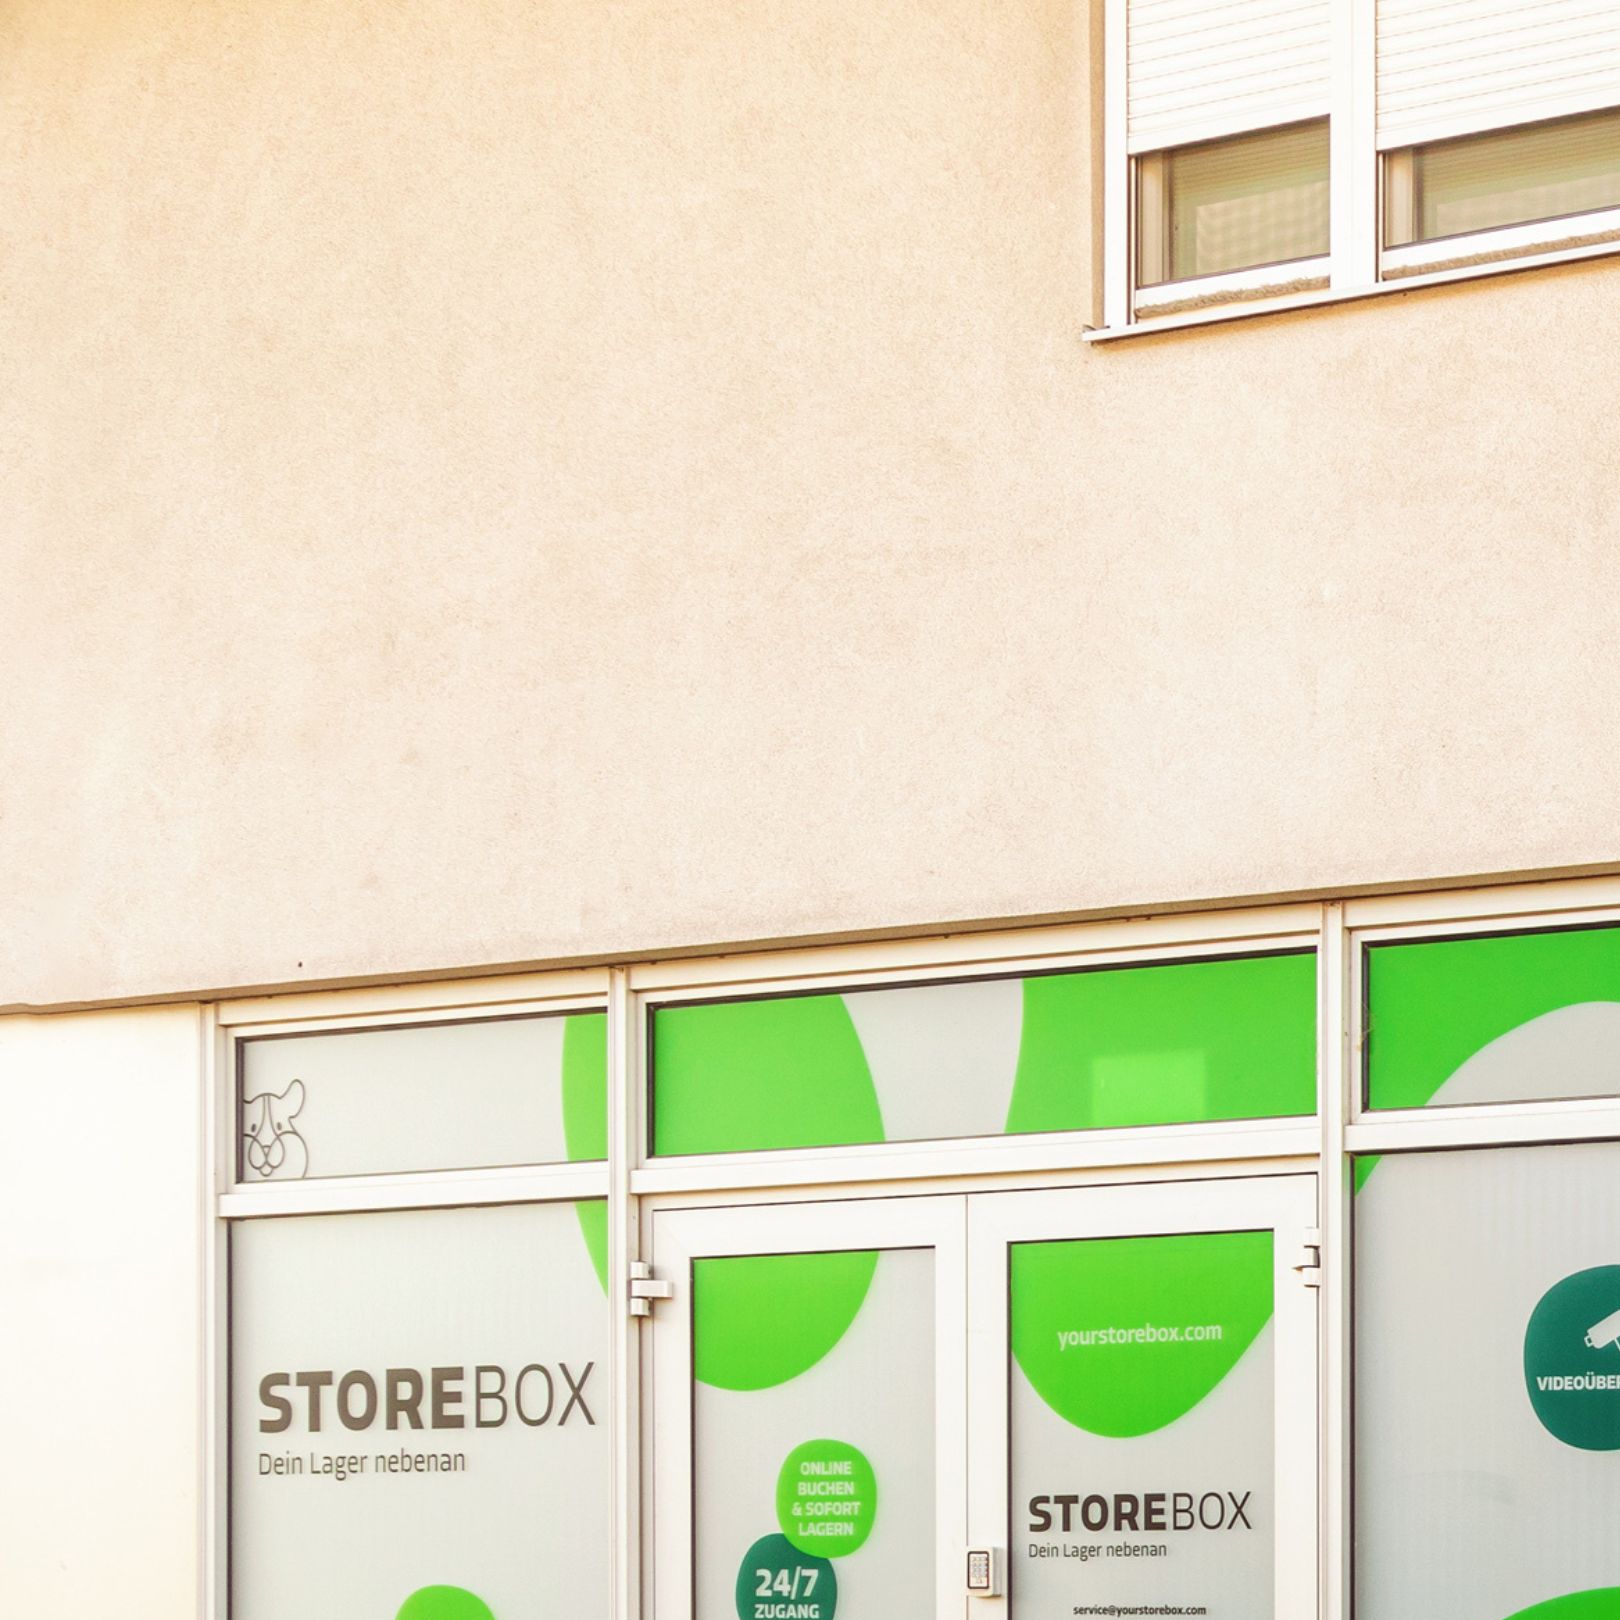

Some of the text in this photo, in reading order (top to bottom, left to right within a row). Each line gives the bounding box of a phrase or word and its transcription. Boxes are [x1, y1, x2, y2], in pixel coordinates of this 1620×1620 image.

[1057, 1323, 1222, 1351] yourstorebox.com
[259, 1362, 595, 1433] STOREBOX
[259, 1448, 465, 1481] Dein Lager nebenan
[800, 1461, 852, 1476] ONLINE
[797, 1482, 855, 1496] BUCHEN
[792, 1502, 861, 1516] & SOFORT
[1028, 1491, 1252, 1533] STOREBOX
[799, 1522, 854, 1536] LAGERN
[1028, 1541, 1167, 1562] Dein Lager nebenan
[755, 1565, 819, 1600] 24/7
[754, 1604, 820, 1619] ZUGANG
[1073, 1604, 1207, 1618] service@yourstorebox.com
